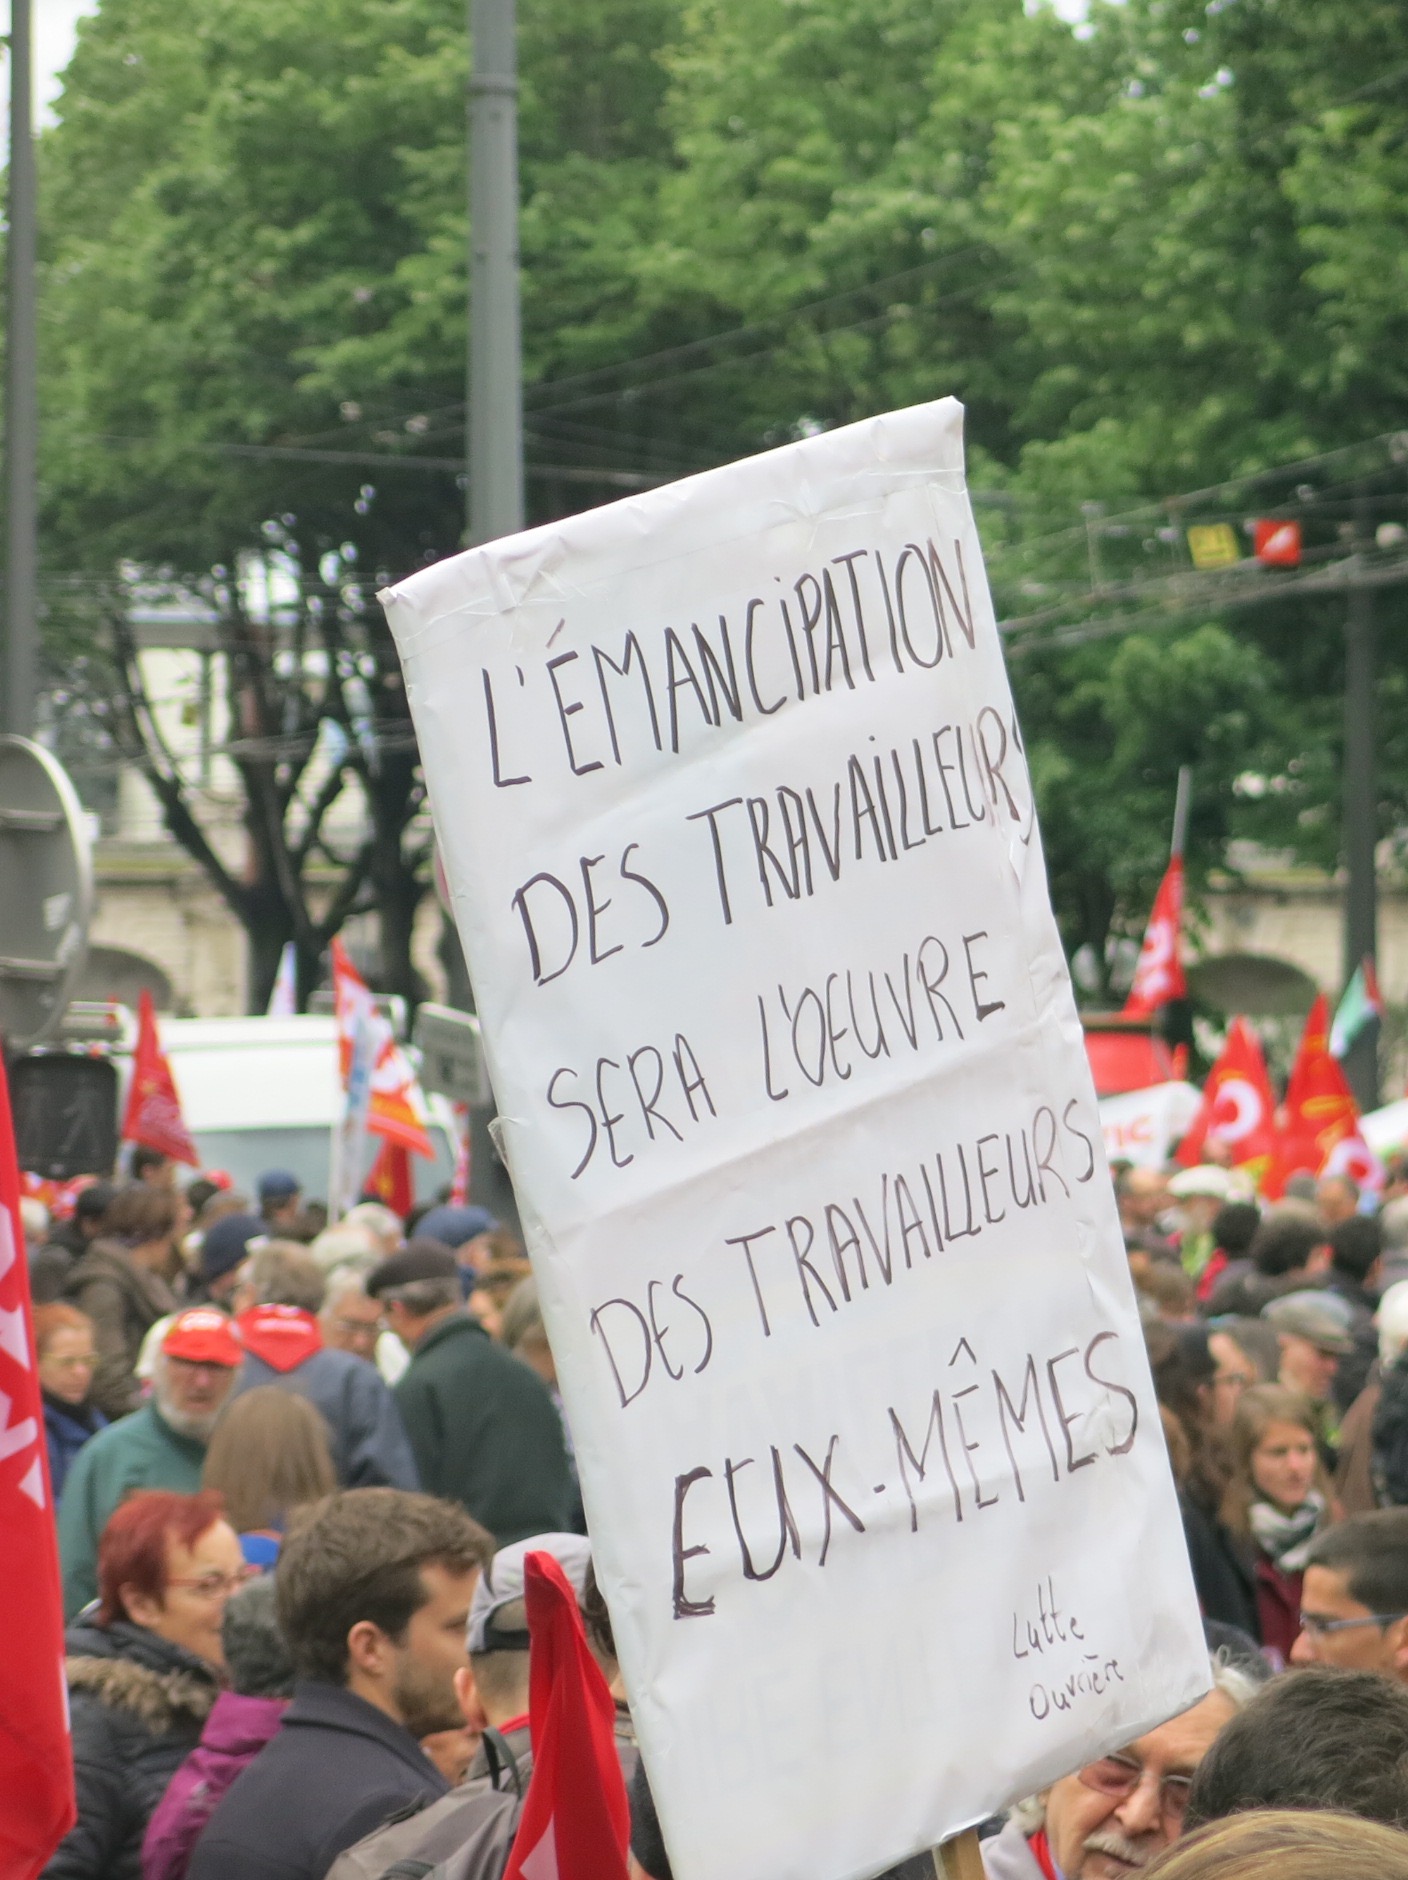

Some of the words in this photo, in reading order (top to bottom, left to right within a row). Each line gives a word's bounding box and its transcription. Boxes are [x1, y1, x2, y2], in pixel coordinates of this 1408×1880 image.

[510, 842, 670, 988] DES
[546, 1032, 718, 1181] SERA
[589, 1272, 714, 1409] DES
[725, 1097, 1095, 1338] TRAVAILLEURS
[671, 1330, 1138, 1621] EUX-MÊMES
[1012, 1574, 1085, 1660] Lutte
